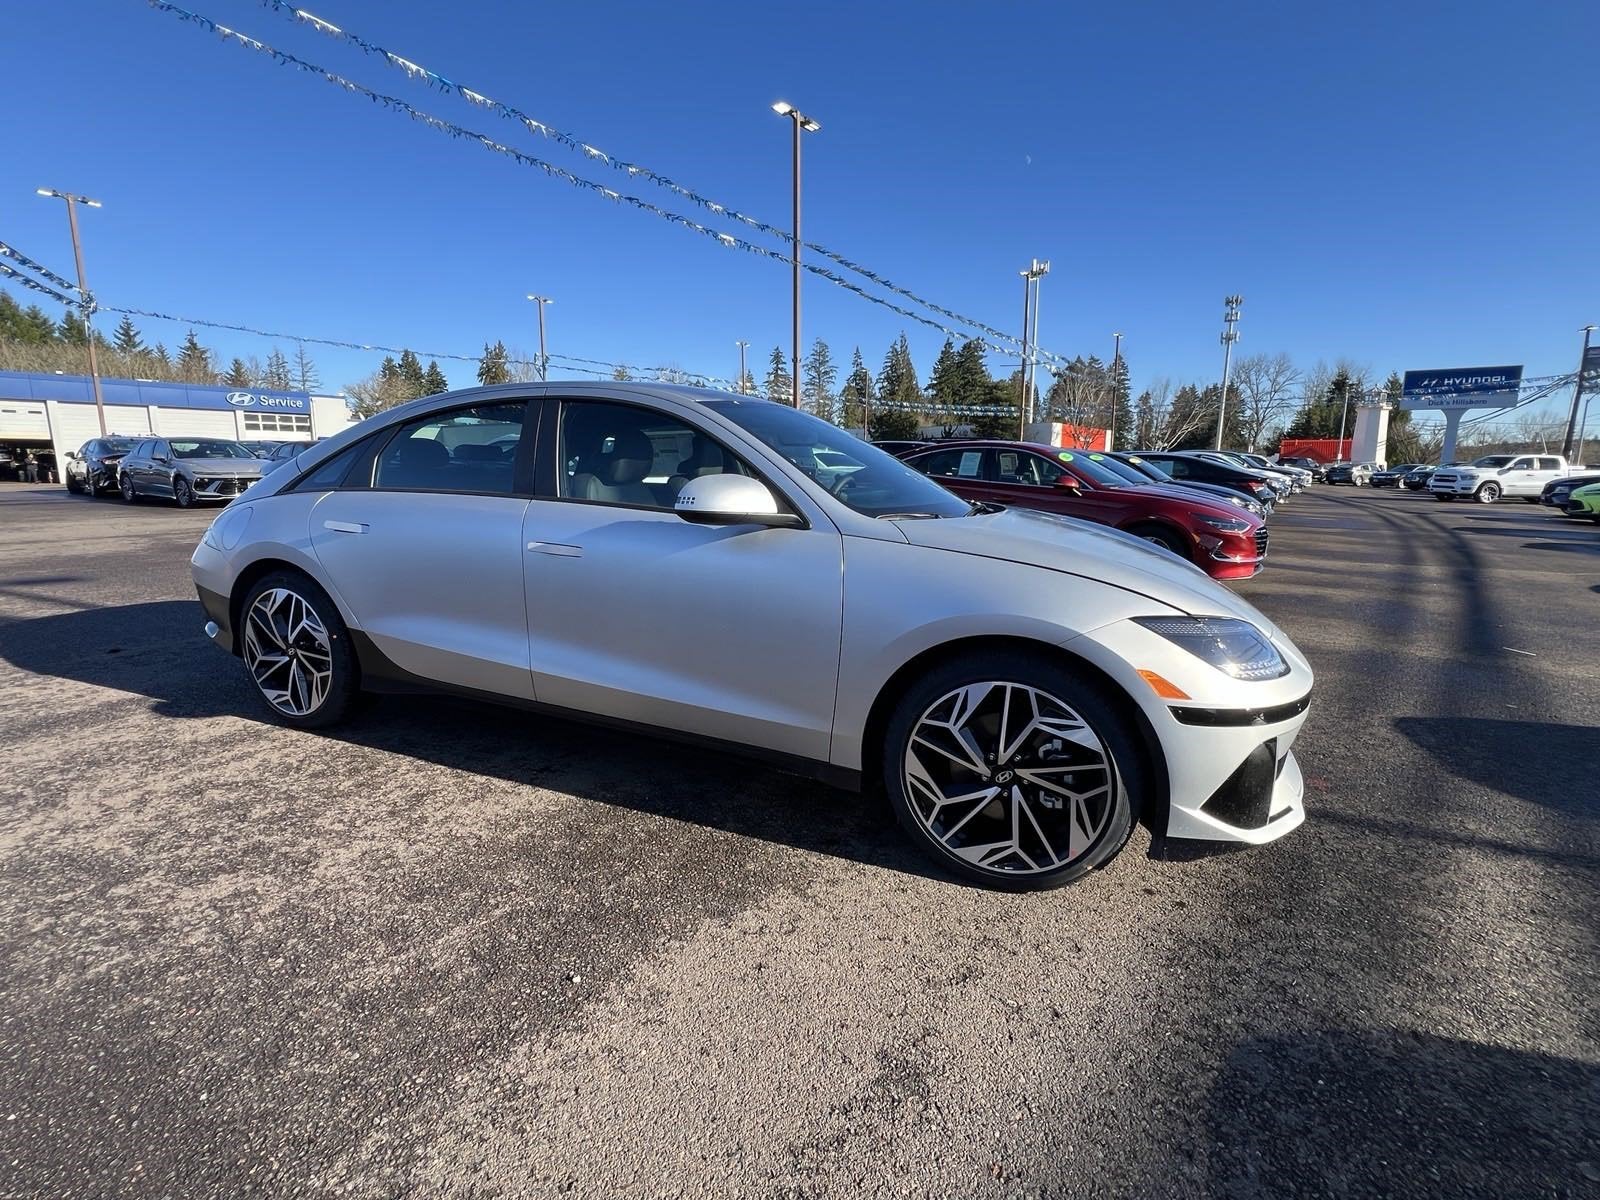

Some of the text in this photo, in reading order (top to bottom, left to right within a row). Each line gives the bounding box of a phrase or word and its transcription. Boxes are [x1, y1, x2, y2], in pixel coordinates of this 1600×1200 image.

[1444, 376, 1505, 385] HYUNDAI
[260, 395, 303, 408] Service
[1428, 398, 1488, 407] Dick's Hillsboro
